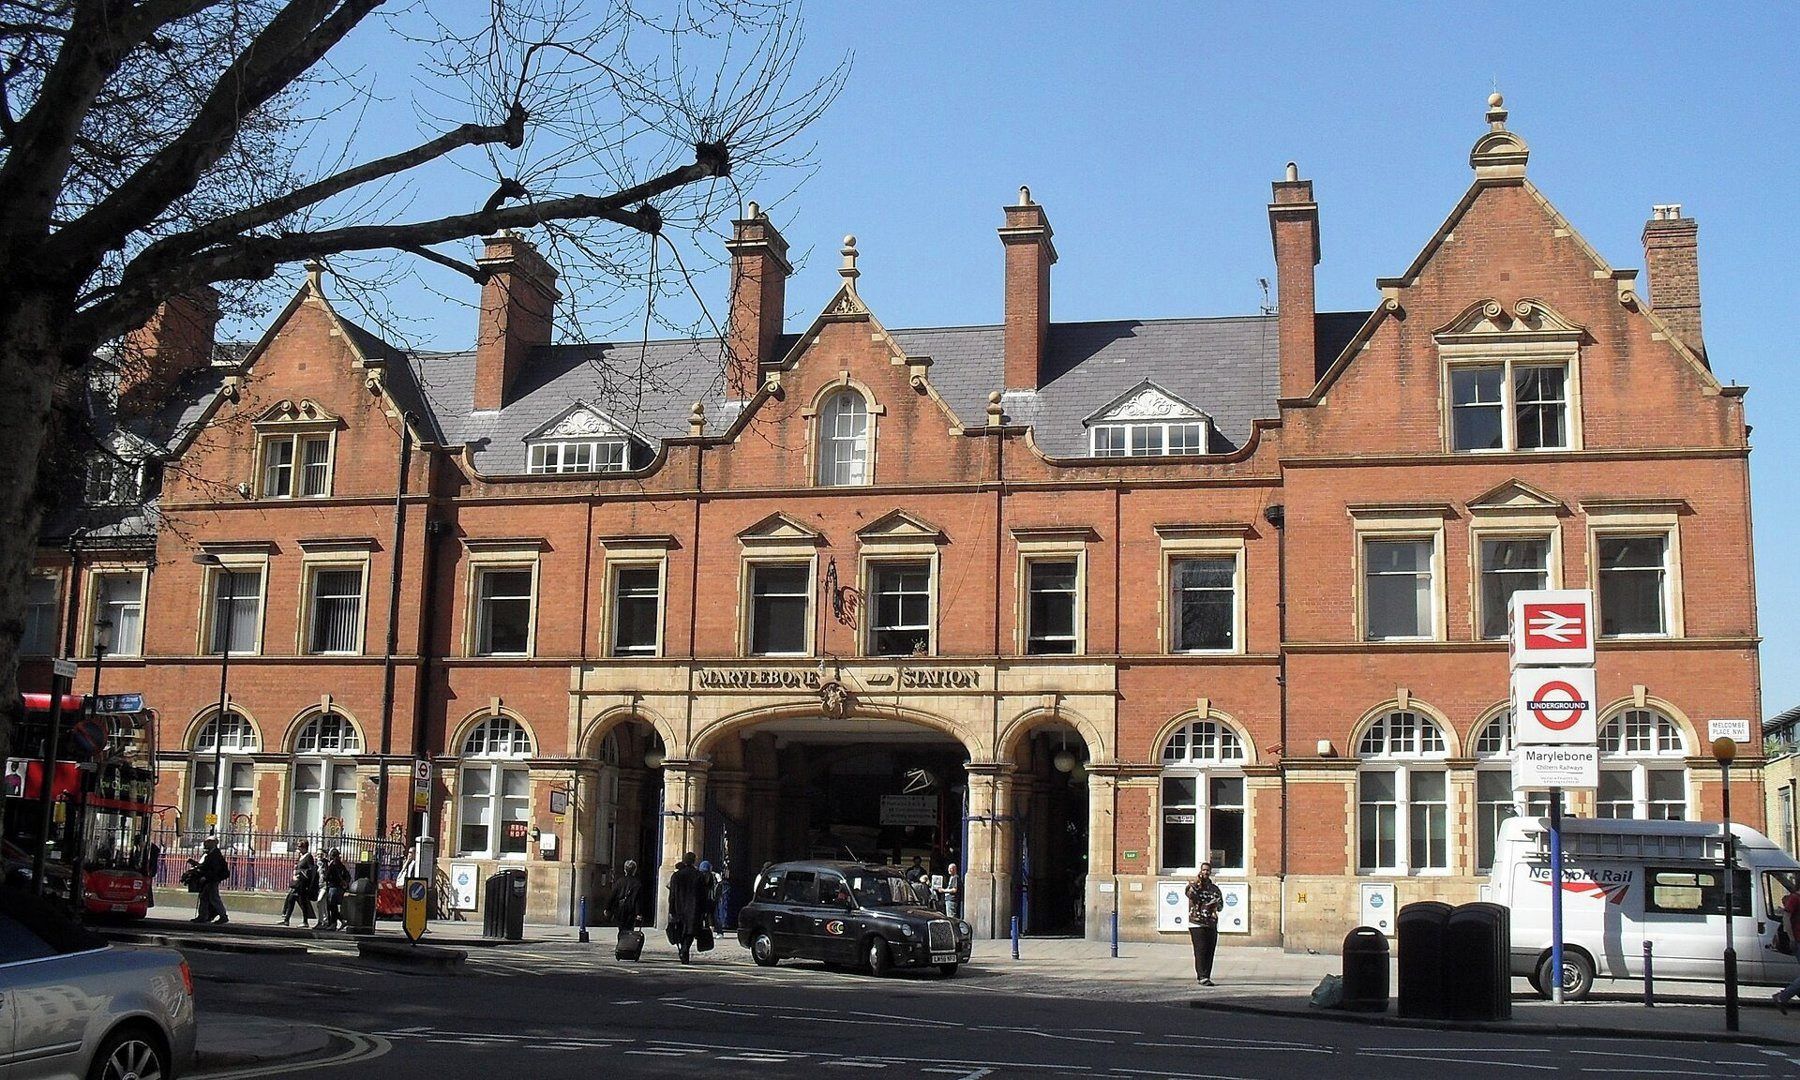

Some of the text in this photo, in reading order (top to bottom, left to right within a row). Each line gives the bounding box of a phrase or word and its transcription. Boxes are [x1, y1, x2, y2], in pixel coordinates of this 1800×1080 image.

[699, 669, 979, 687] MARYLEBONE STATION
[1526, 751, 1593, 763] Marylebone
[1529, 867, 1633, 882] Nework Rail
